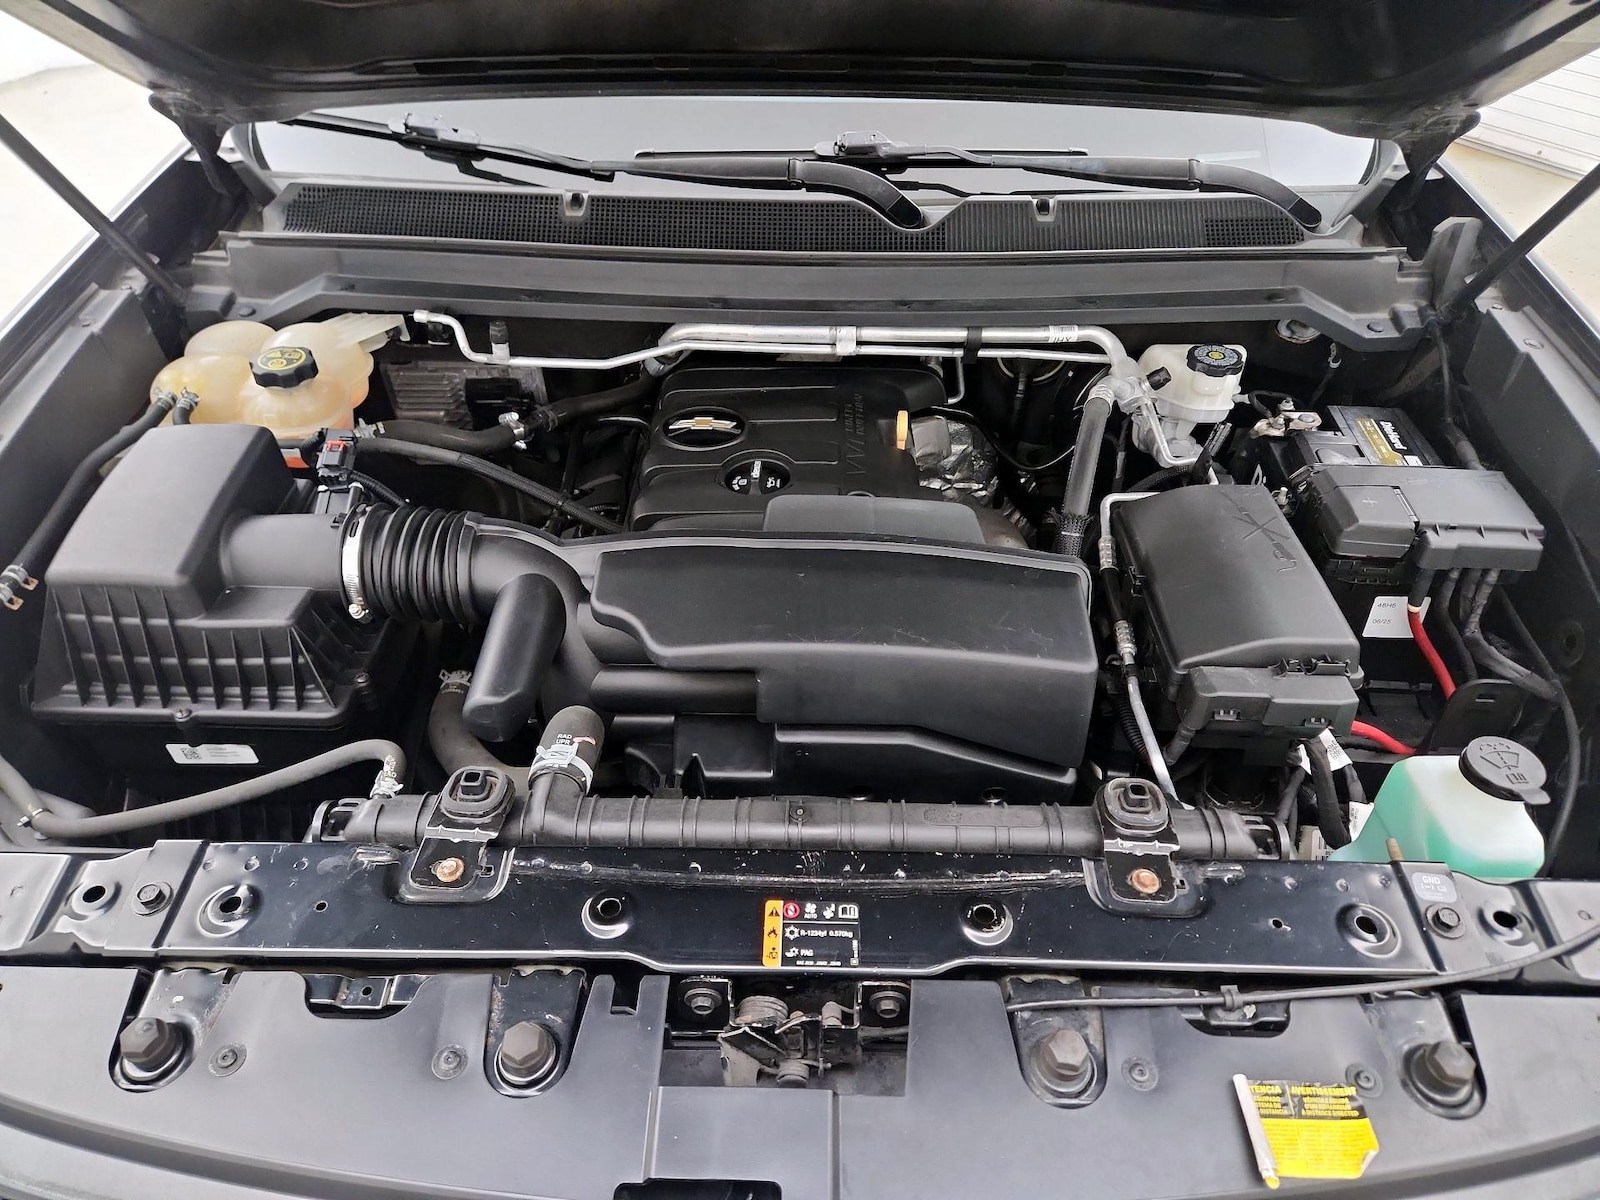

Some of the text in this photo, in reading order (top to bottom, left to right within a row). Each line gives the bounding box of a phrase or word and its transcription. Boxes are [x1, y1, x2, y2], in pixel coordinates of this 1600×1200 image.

[1380, 421, 1407, 450] DieHard
[1422, 875, 1441, 885] GND
[800, 929, 828, 938] R-1234yf
[800, 949, 814, 957] PAG
